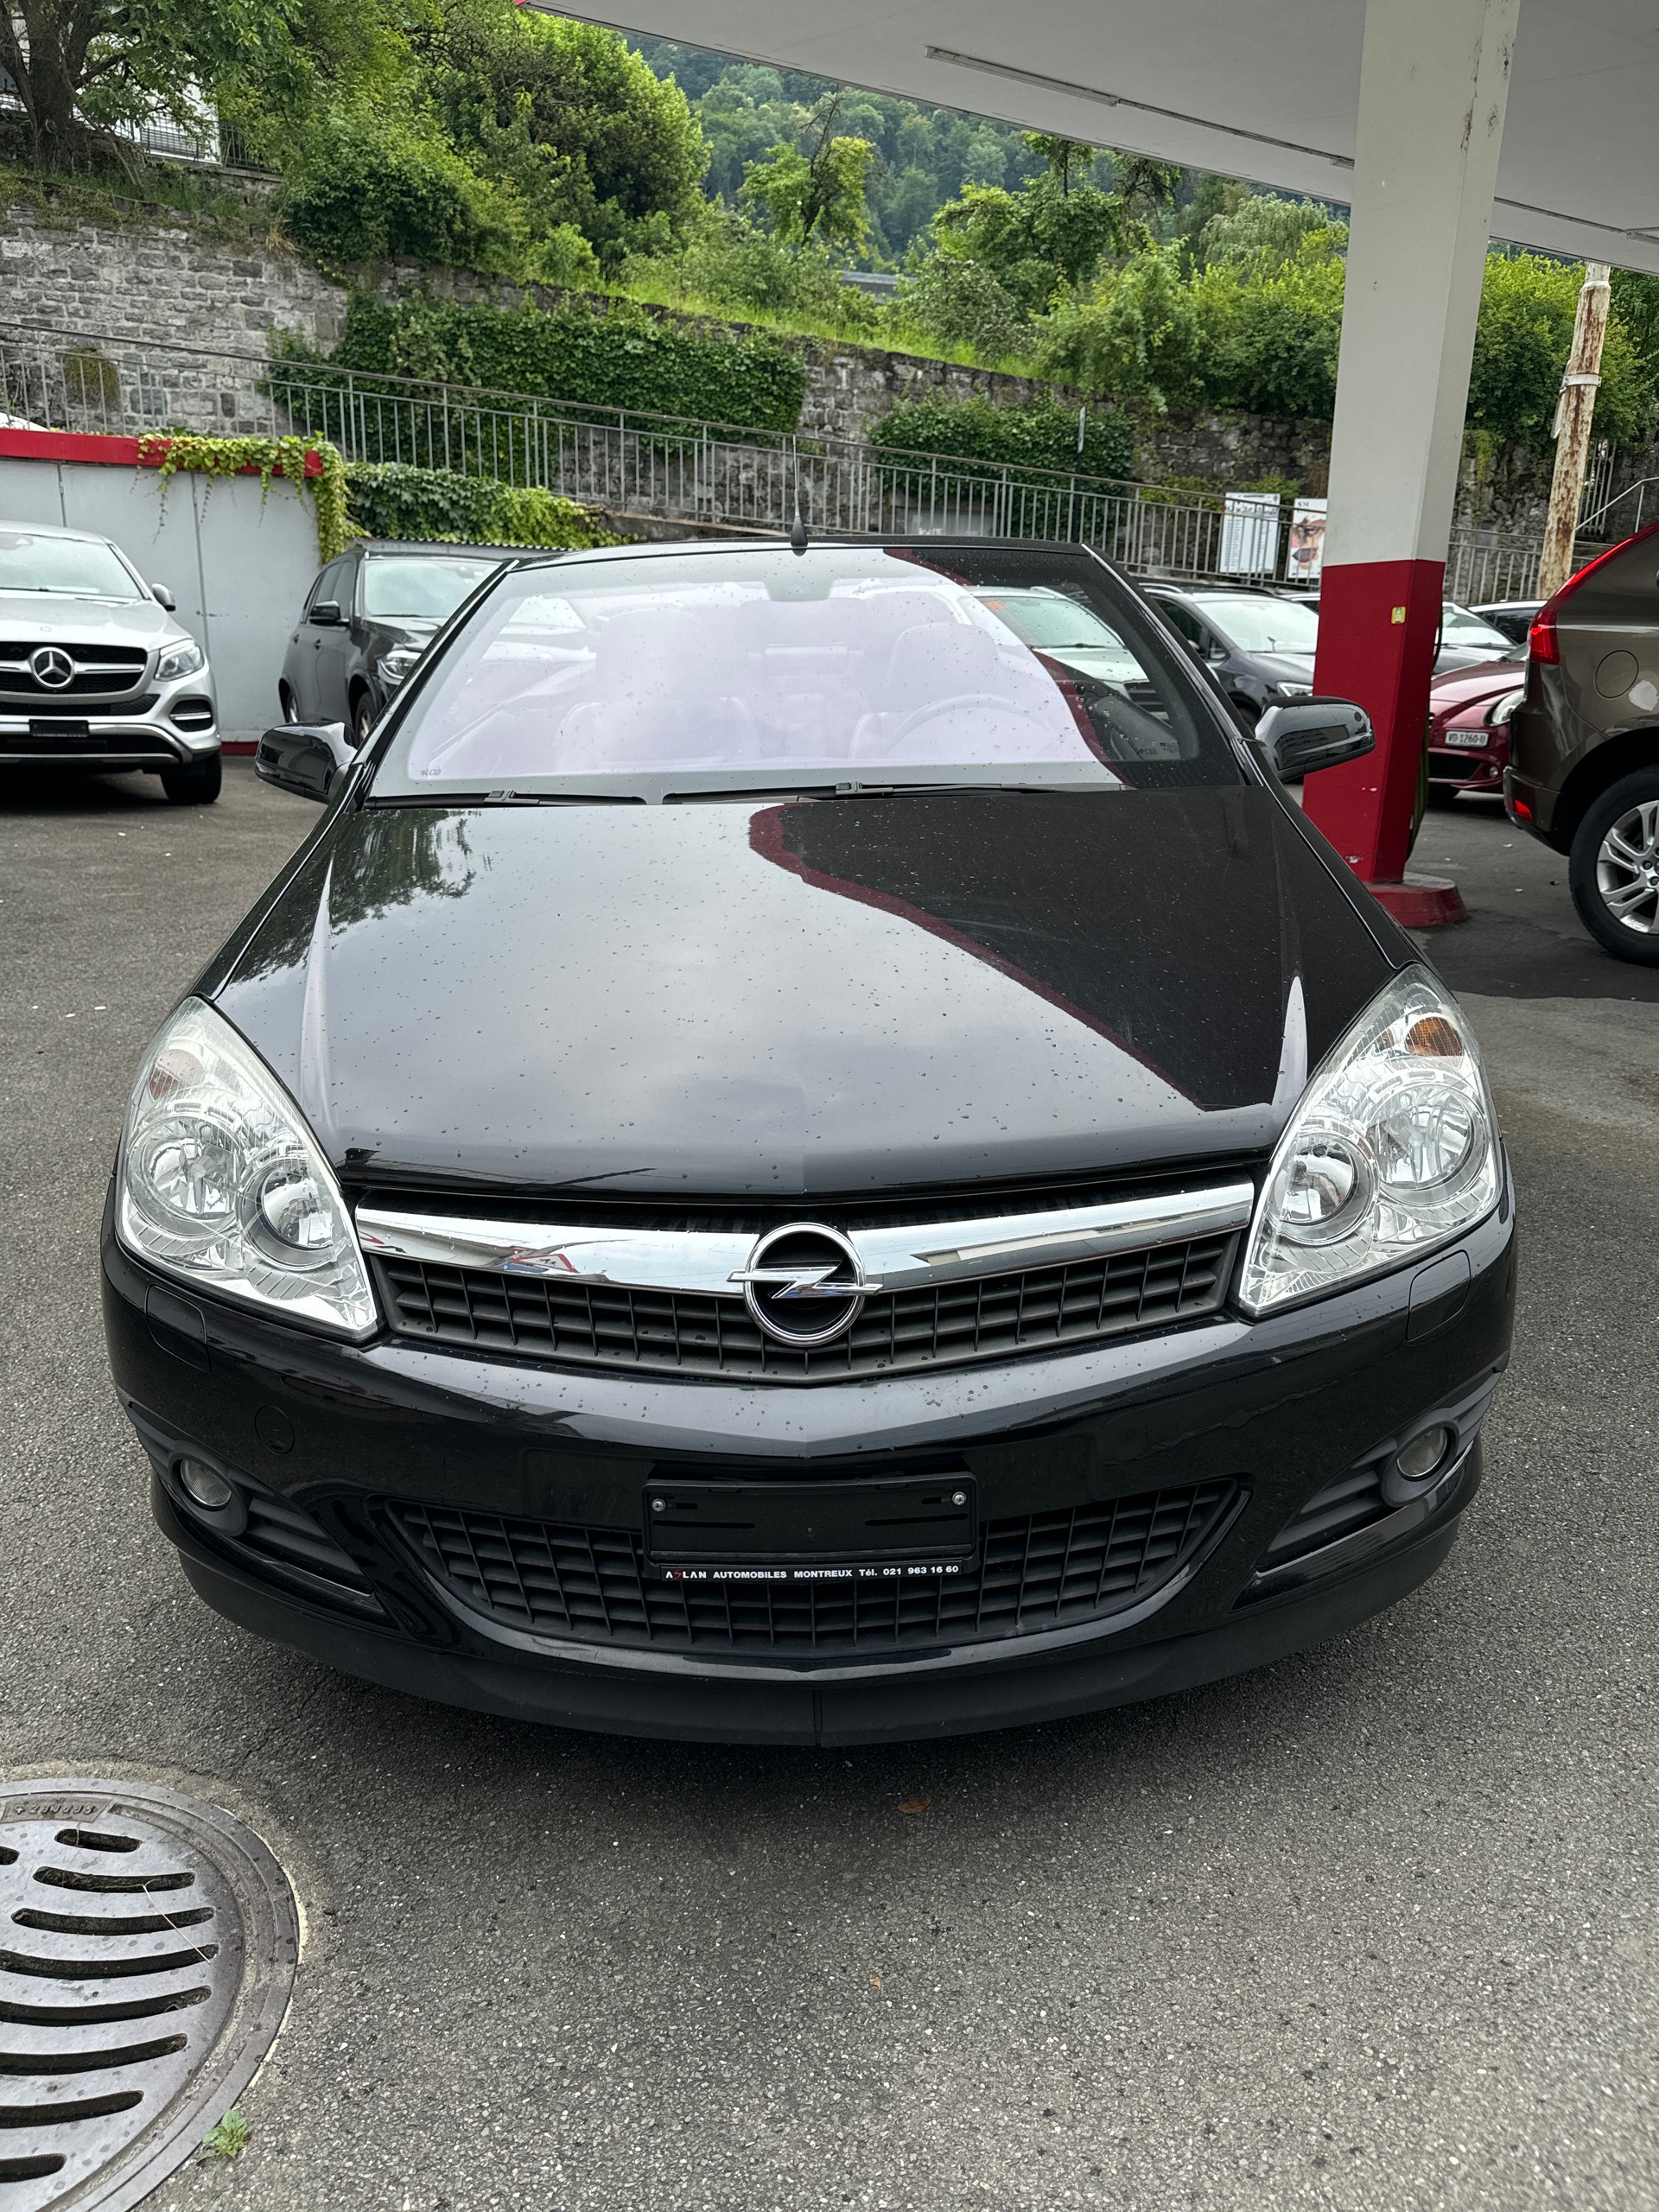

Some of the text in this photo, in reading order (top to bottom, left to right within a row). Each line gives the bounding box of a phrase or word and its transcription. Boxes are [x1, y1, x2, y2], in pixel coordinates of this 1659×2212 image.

[665, 1570, 707, 1580] ASLAN
[713, 1571, 787, 1580] AUTOMOBILES
[794, 1569, 853, 1579] MONTREUX
[859, 1568, 878, 1577] Tél.
[882, 1567, 902, 1576] 021
[907, 1567, 928, 1575] 963
[945, 1565, 959, 1573] 60
